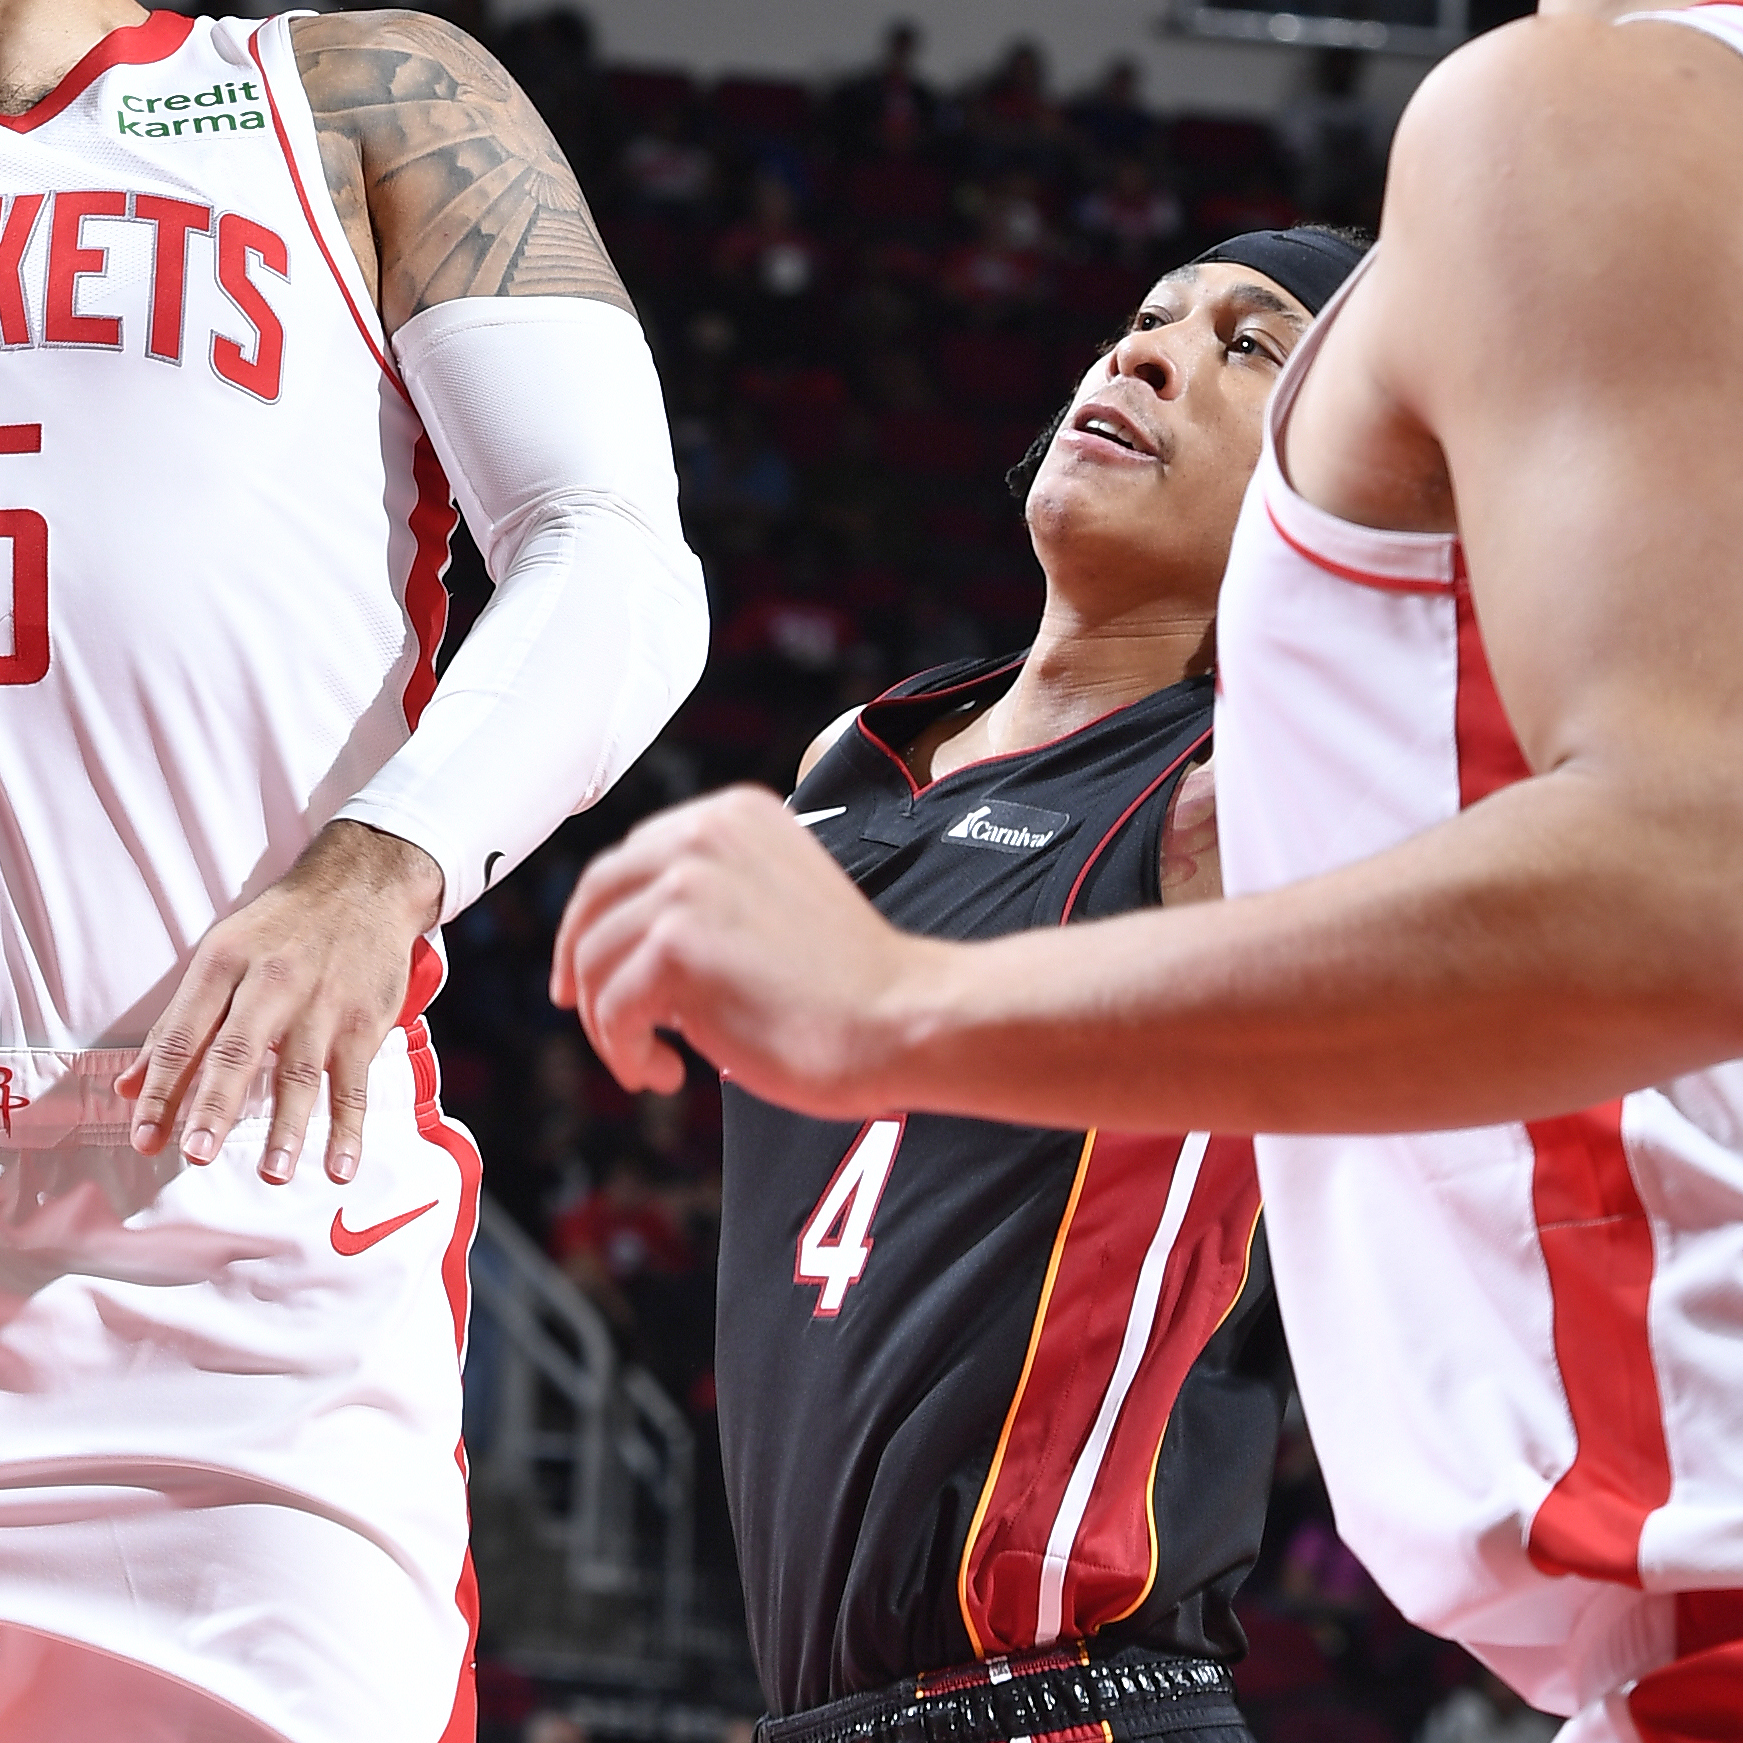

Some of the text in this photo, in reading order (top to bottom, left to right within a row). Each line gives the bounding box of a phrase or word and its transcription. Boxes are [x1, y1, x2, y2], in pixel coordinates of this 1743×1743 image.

[122, 82, 259, 113] credit
[117, 110, 265, 137] karma
[971, 820, 1054, 848] Carnival
[793, 1112, 908, 1319] 4
